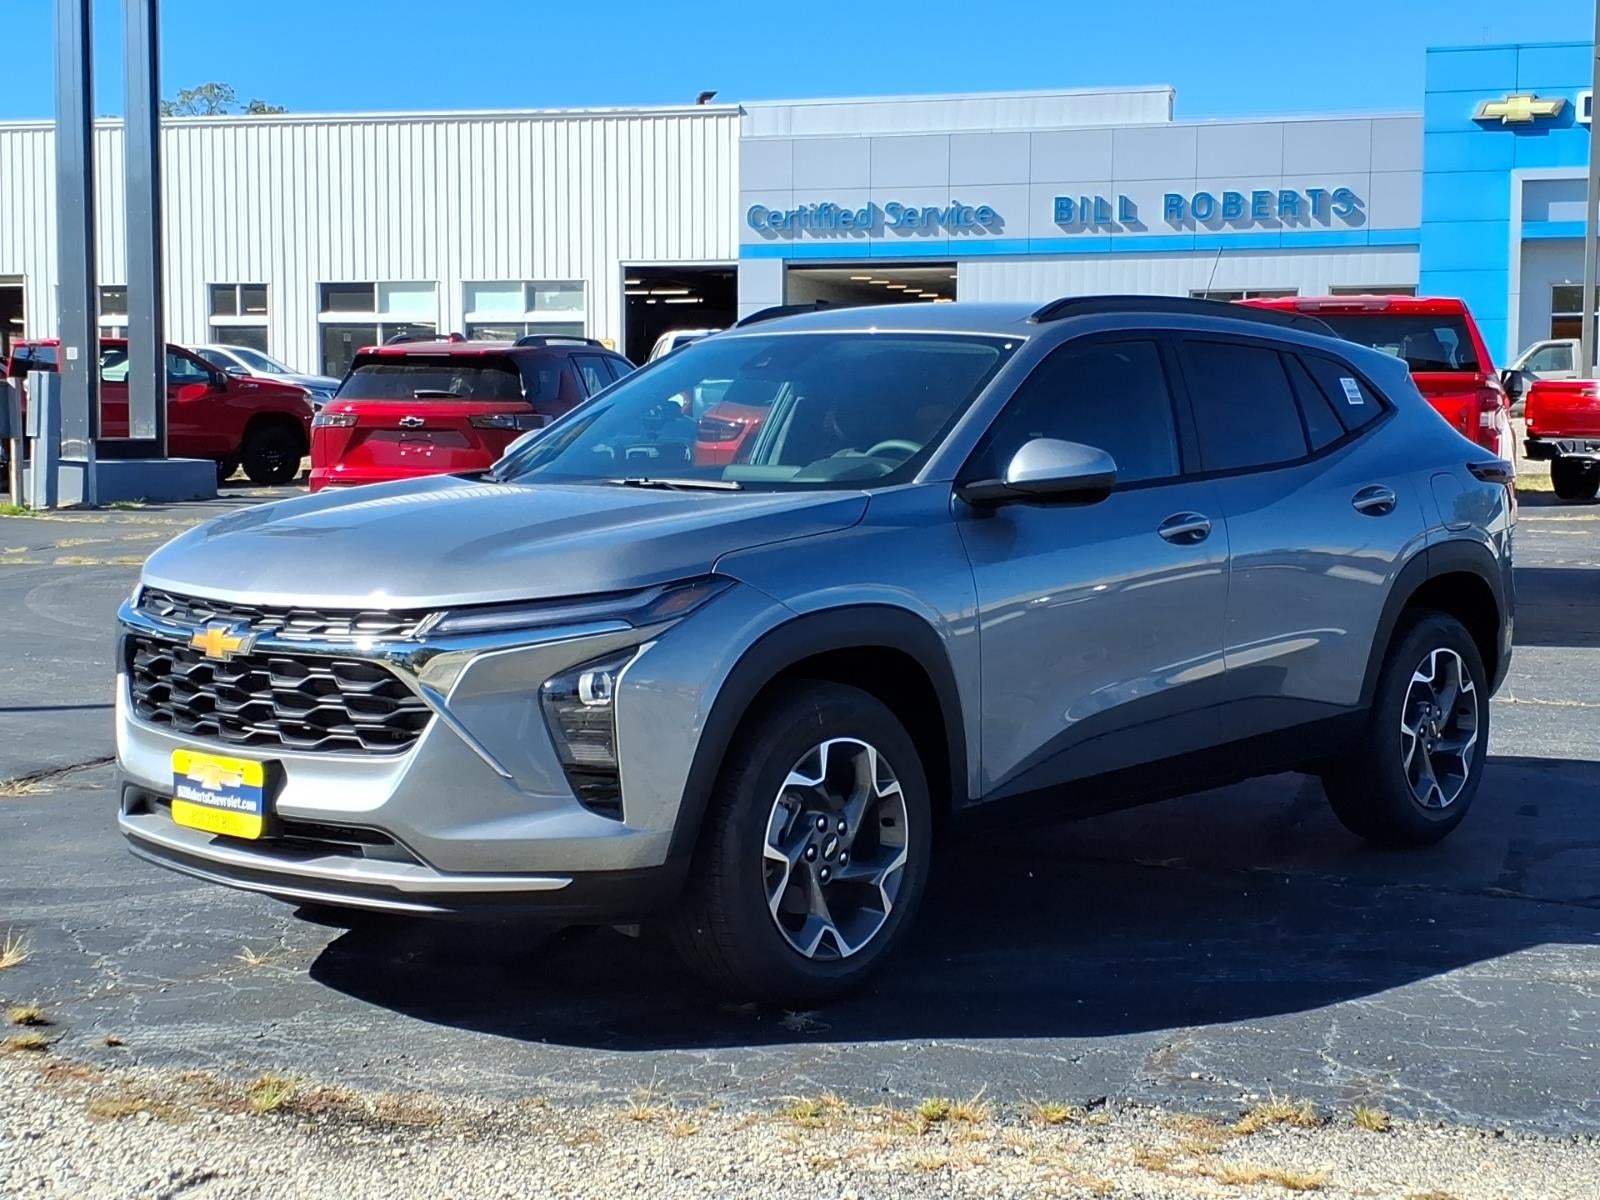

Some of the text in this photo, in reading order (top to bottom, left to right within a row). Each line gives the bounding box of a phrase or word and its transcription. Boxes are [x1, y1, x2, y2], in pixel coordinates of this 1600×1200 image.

[746, 199, 995, 231] Certified Service
[1053, 187, 1356, 225] BILL ROBERTS
